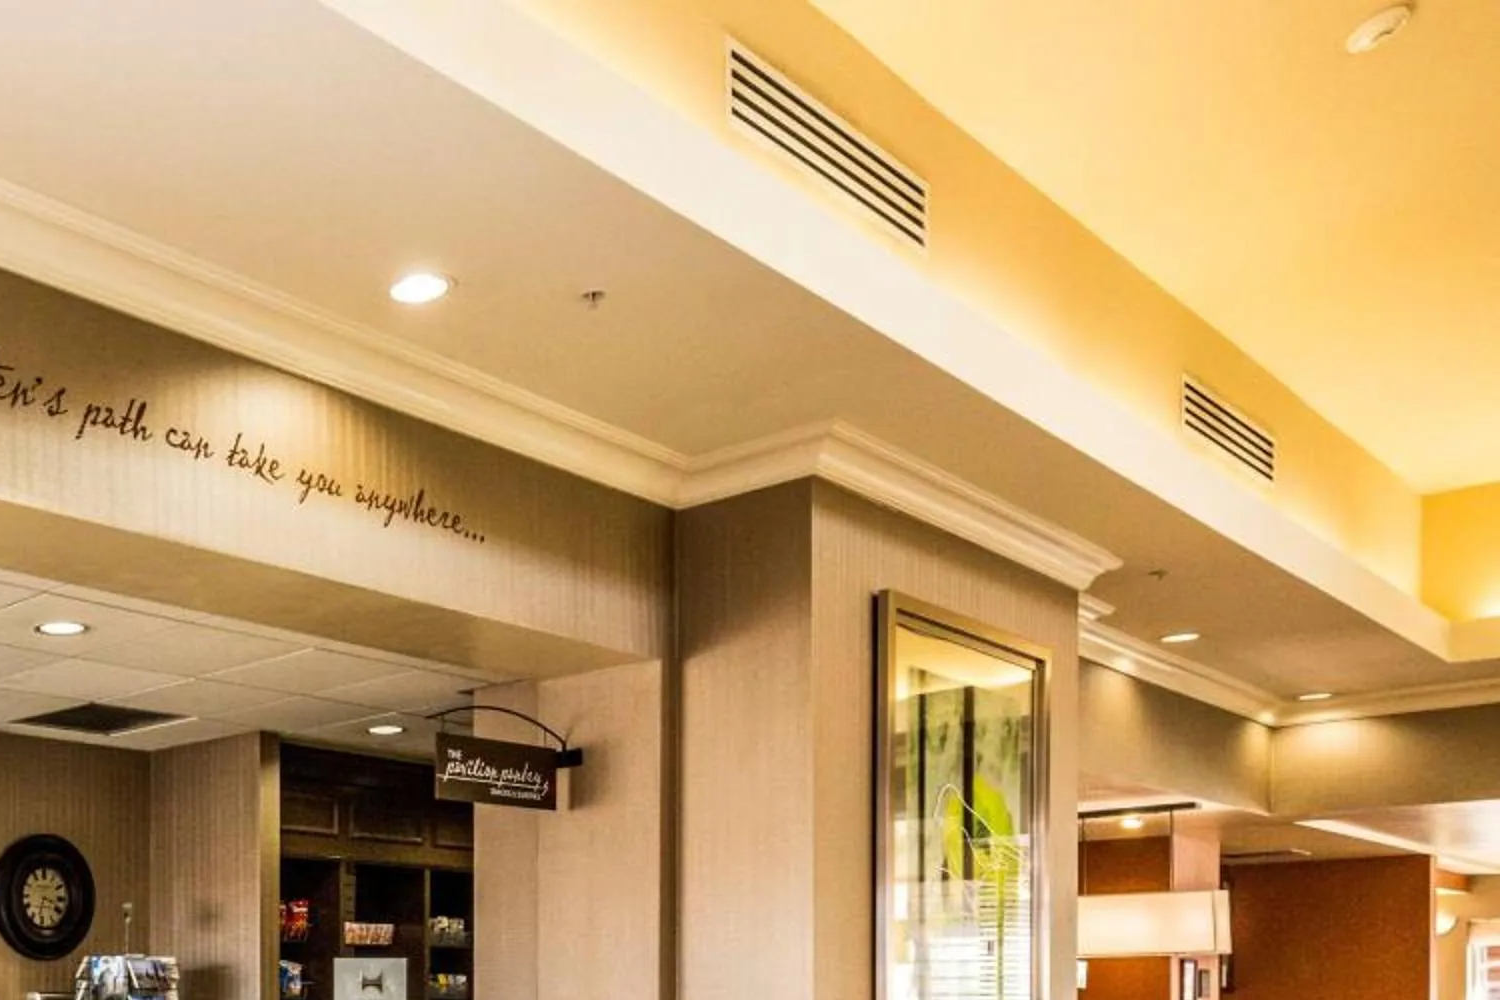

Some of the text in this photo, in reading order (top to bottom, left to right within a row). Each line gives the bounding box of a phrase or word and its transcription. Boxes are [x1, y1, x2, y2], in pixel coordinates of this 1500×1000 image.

[75, 398, 153, 440] path
[165, 426, 214, 461] can
[226, 432, 285, 485] take
[296, 469, 342, 504] you
[355, 484, 486, 544] anywhere...
